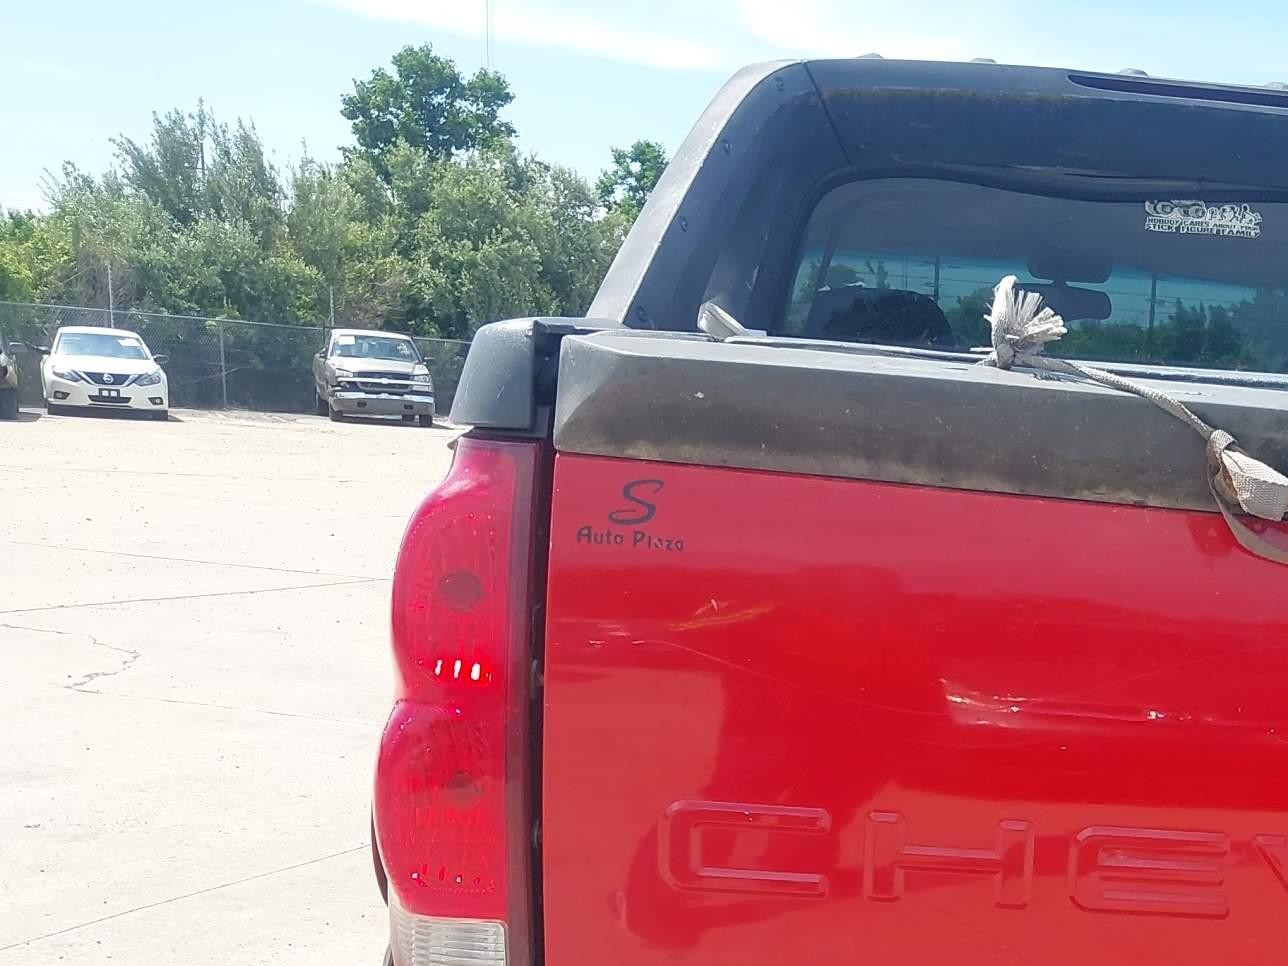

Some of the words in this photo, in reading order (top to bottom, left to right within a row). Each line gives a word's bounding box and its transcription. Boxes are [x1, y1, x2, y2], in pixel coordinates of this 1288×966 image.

[1181, 225, 1216, 234] FIGURE
[1220, 228, 1260, 237] FAMILY
[608, 479, 665, 525] S
[576, 526, 624, 544] Auto
[633, 530, 684, 551] Plaza
